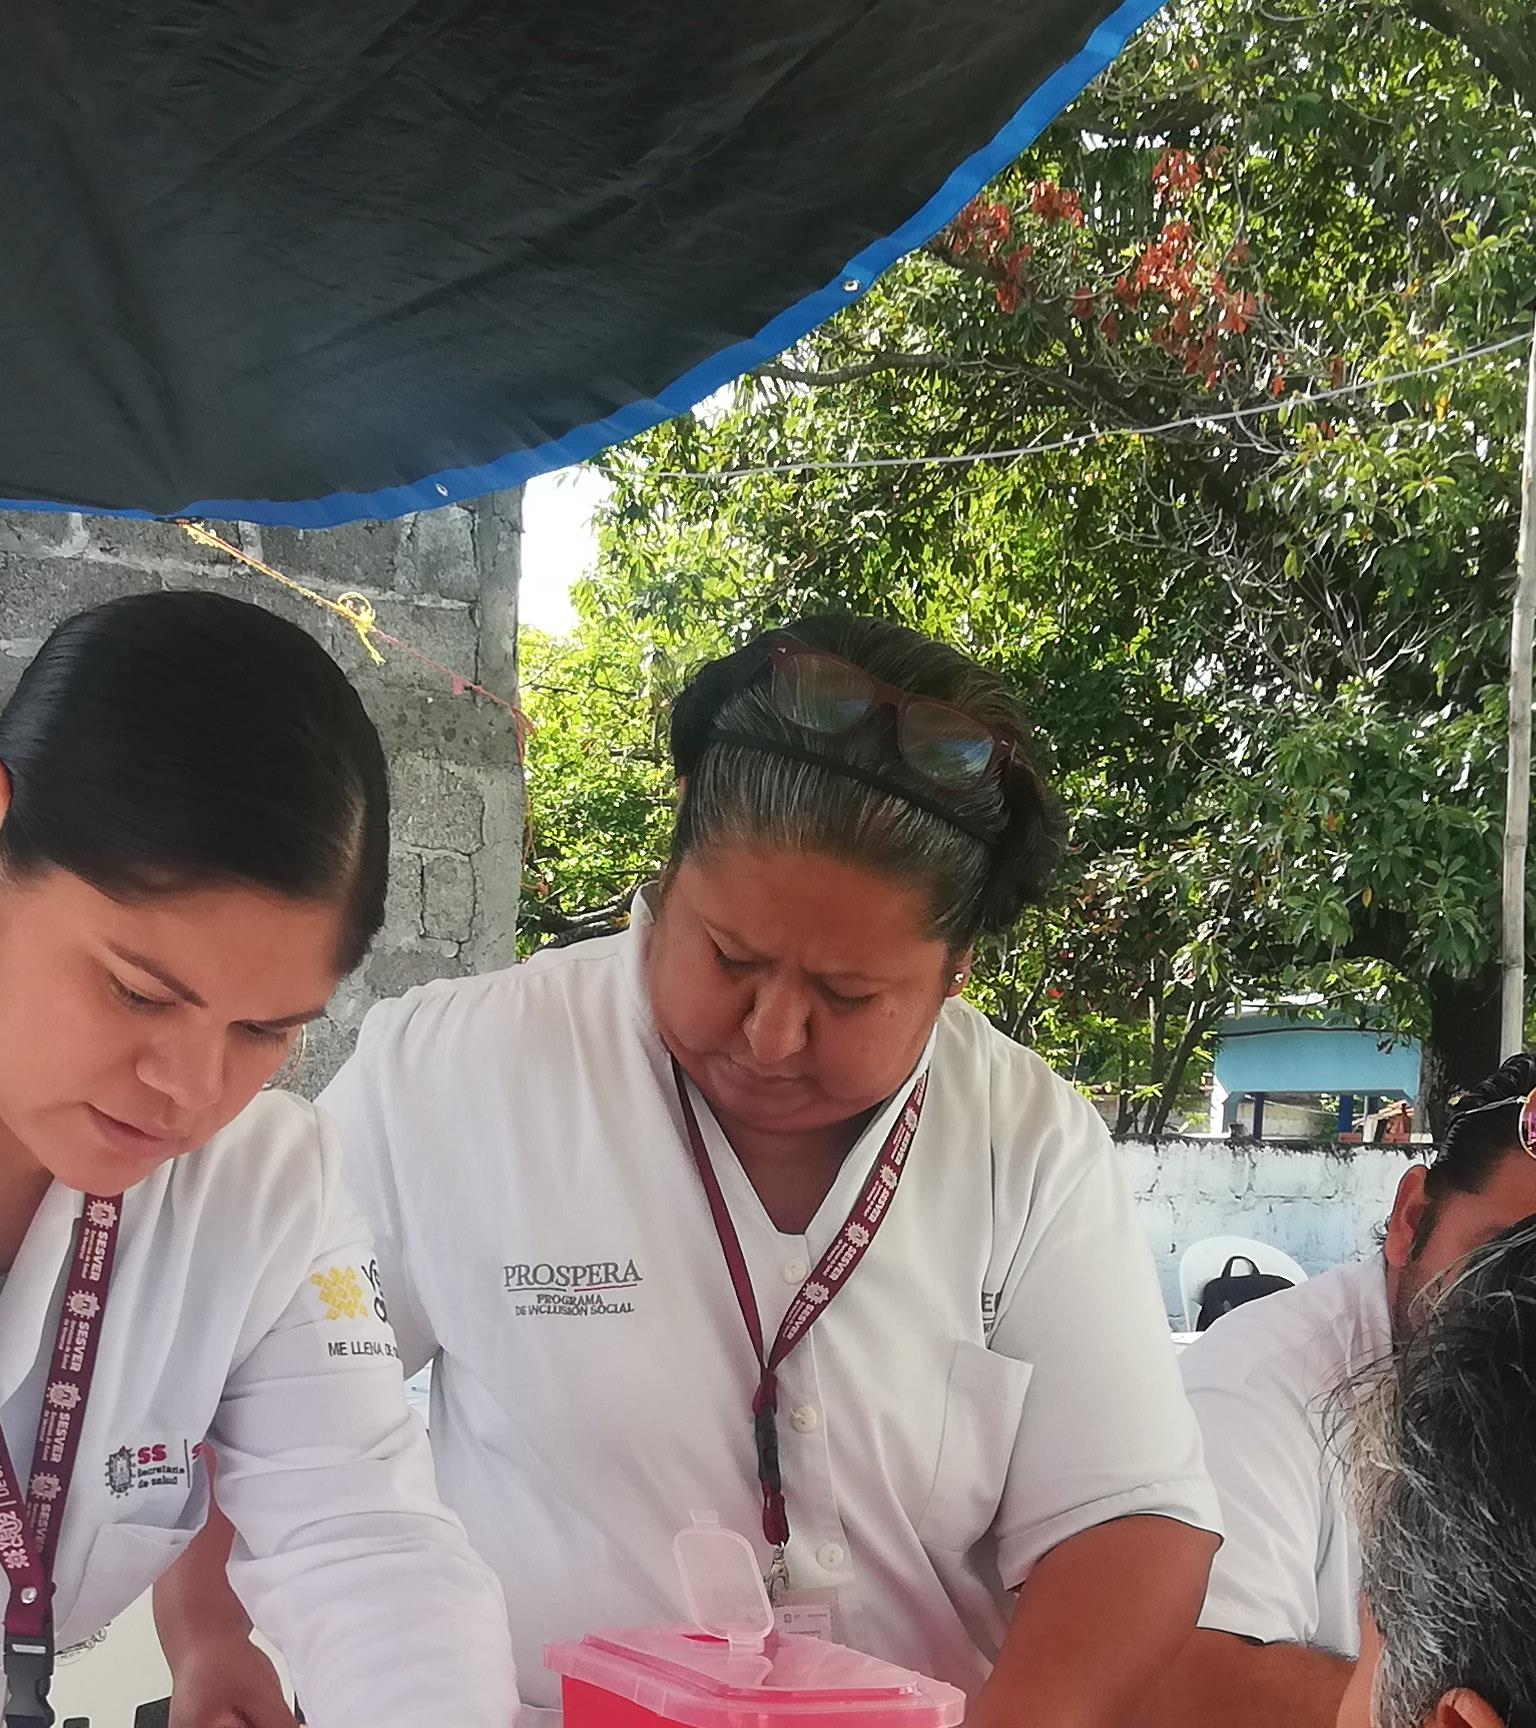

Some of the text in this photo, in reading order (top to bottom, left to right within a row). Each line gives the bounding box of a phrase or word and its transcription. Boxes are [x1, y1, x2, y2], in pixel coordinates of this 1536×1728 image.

[89, 1231, 109, 1281] SESVER
[503, 1259, 643, 1287] PROSPERA
[536, 1293, 604, 1306] PROGRAMA
[590, 1302, 635, 1316] SOCIAL
[70, 1321, 89, 1372] SESVER
[328, 1342, 348, 1356] ME
[50, 1412, 70, 1463] SESVER
[138, 1444, 167, 1465] SS
